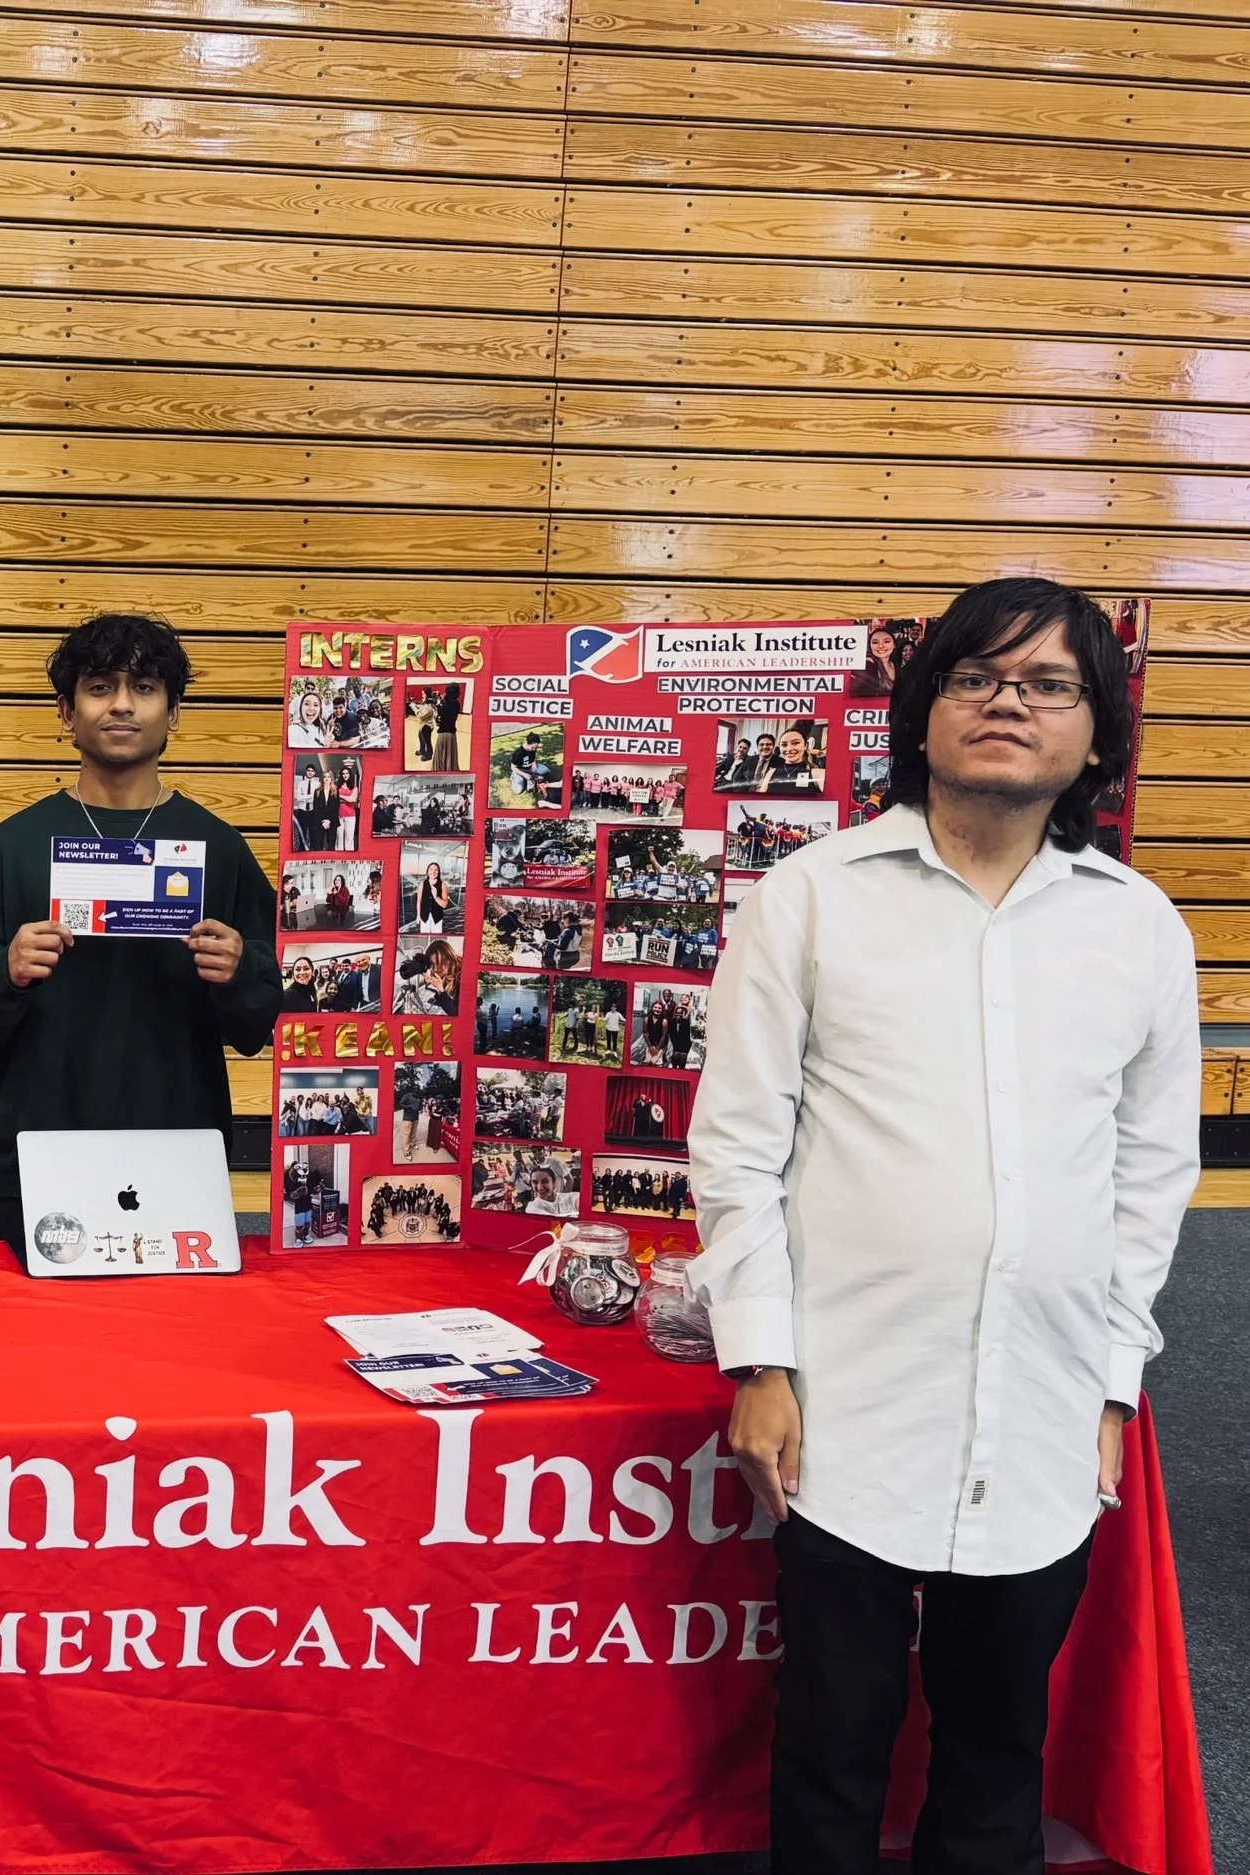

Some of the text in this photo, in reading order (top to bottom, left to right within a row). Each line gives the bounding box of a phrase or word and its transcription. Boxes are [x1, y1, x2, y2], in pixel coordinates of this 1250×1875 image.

[656, 631, 857, 653] Lesniak Institute
[300, 631, 484, 674] INTERNS
[657, 656, 854, 669] for AMERICAN LEADERSHIP
[494, 677, 568, 693] SOCIAL
[658, 676, 842, 692] ENVIRONMENTAL
[490, 698, 572, 716] JUSTICE
[679, 697, 815, 713] PROTECTION
[589, 716, 670, 733] ANIMAL
[581, 737, 680, 754] WELFARE
[81, 842, 101, 850] OUR
[58, 851, 119, 860] NEWSLETTER!
[527, 867, 588, 876] Lesniak Institute
[648, 942, 670, 953] RUN
[172, 1230, 218, 1269] R
[359, 1363, 426, 1371] NEWSLETTER!
